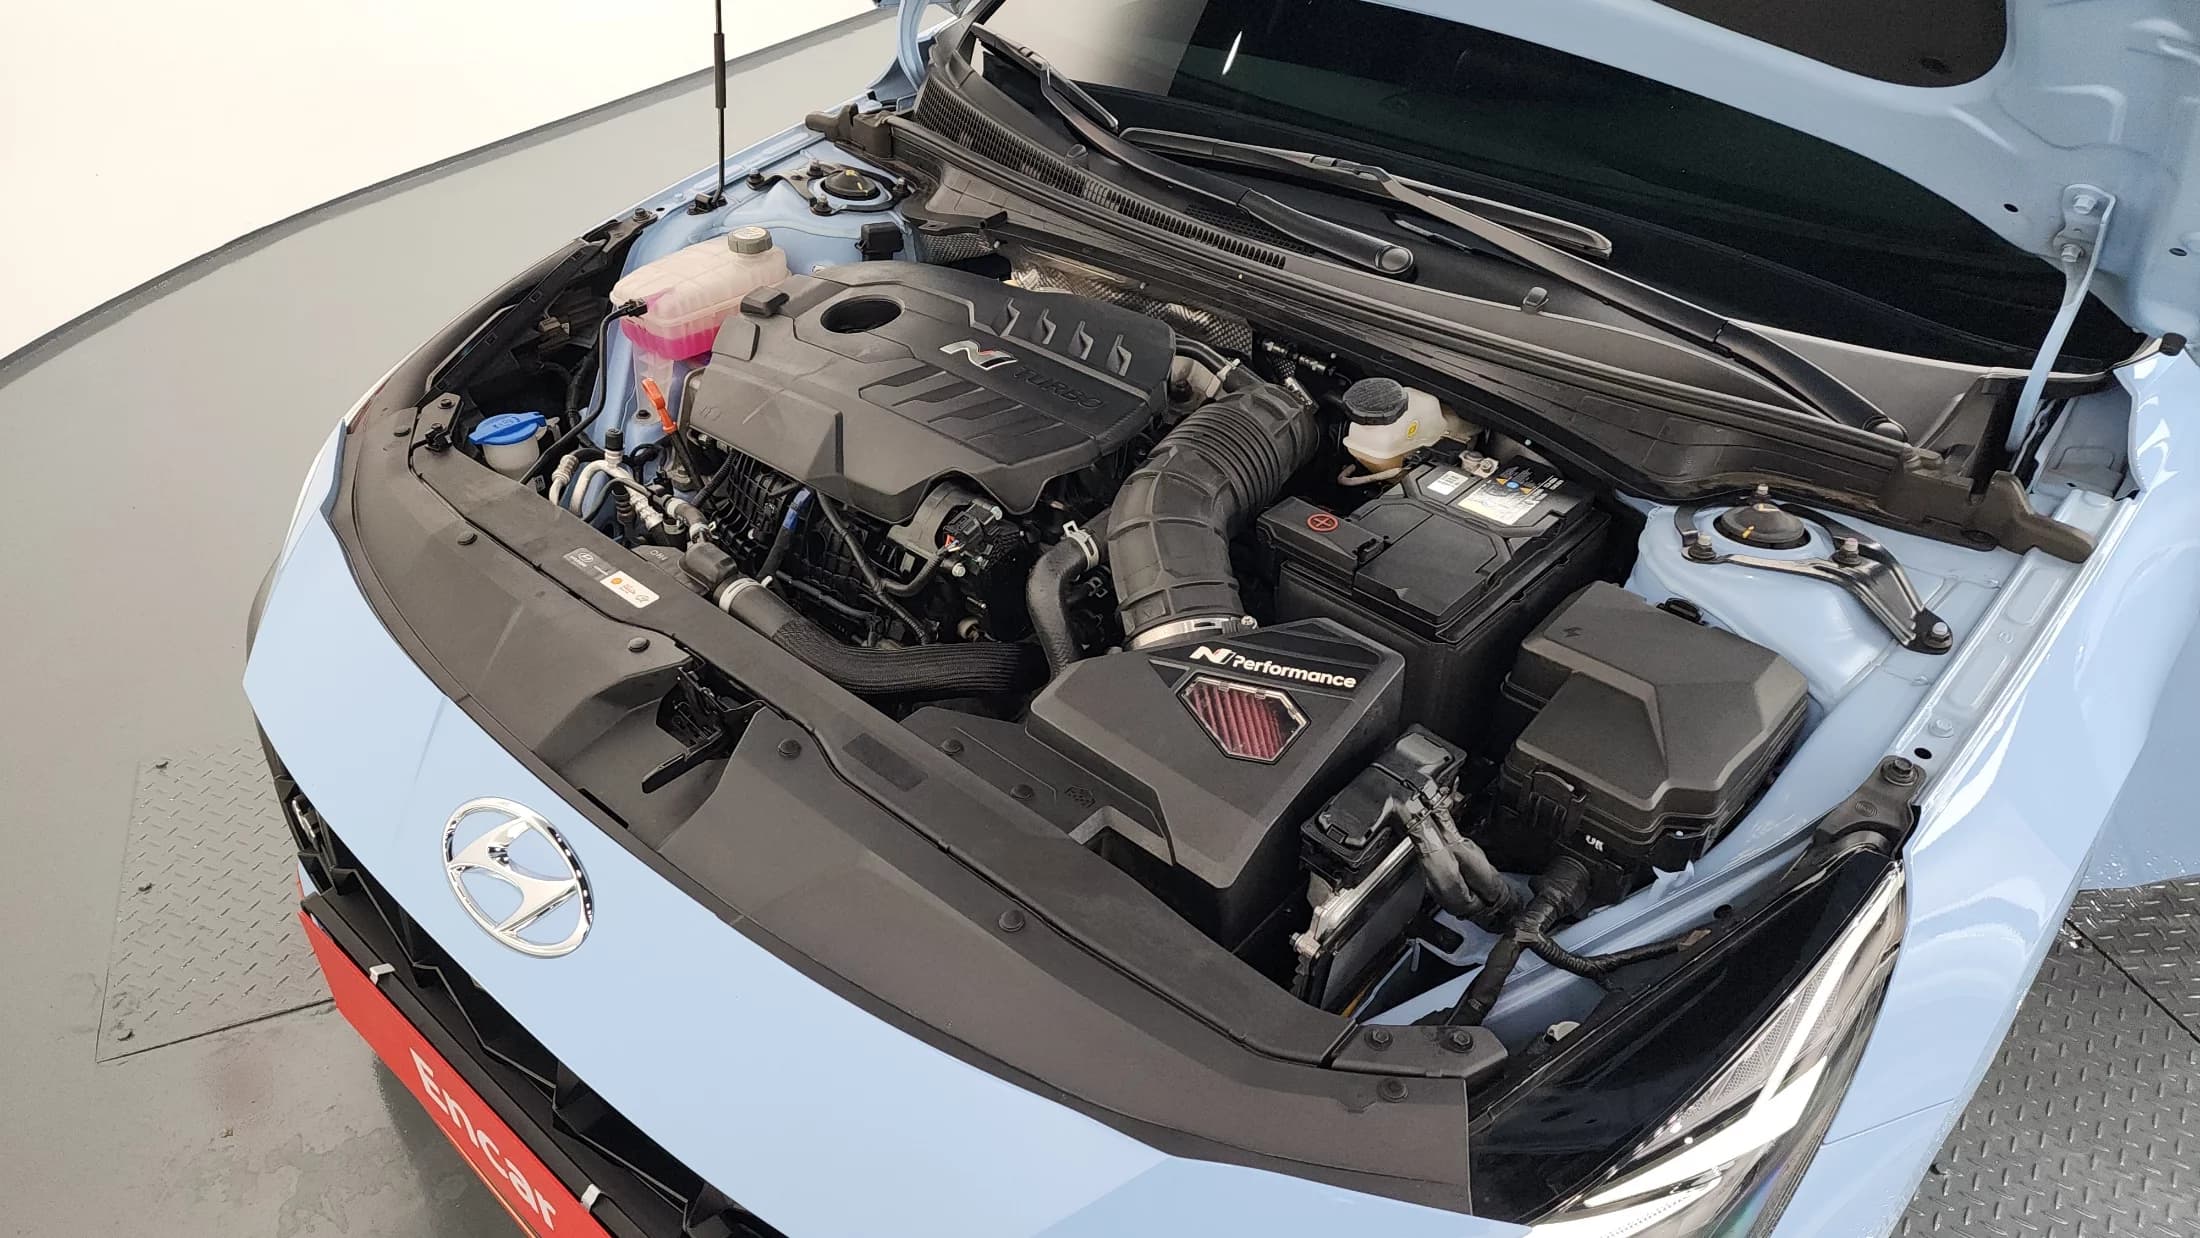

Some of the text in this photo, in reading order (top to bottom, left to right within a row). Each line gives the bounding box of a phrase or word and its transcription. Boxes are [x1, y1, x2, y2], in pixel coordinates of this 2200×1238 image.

[1011, 365, 1104, 409] TURBO
[1232, 655, 1357, 688] Performance
[409, 1047, 557, 1231] Encar
